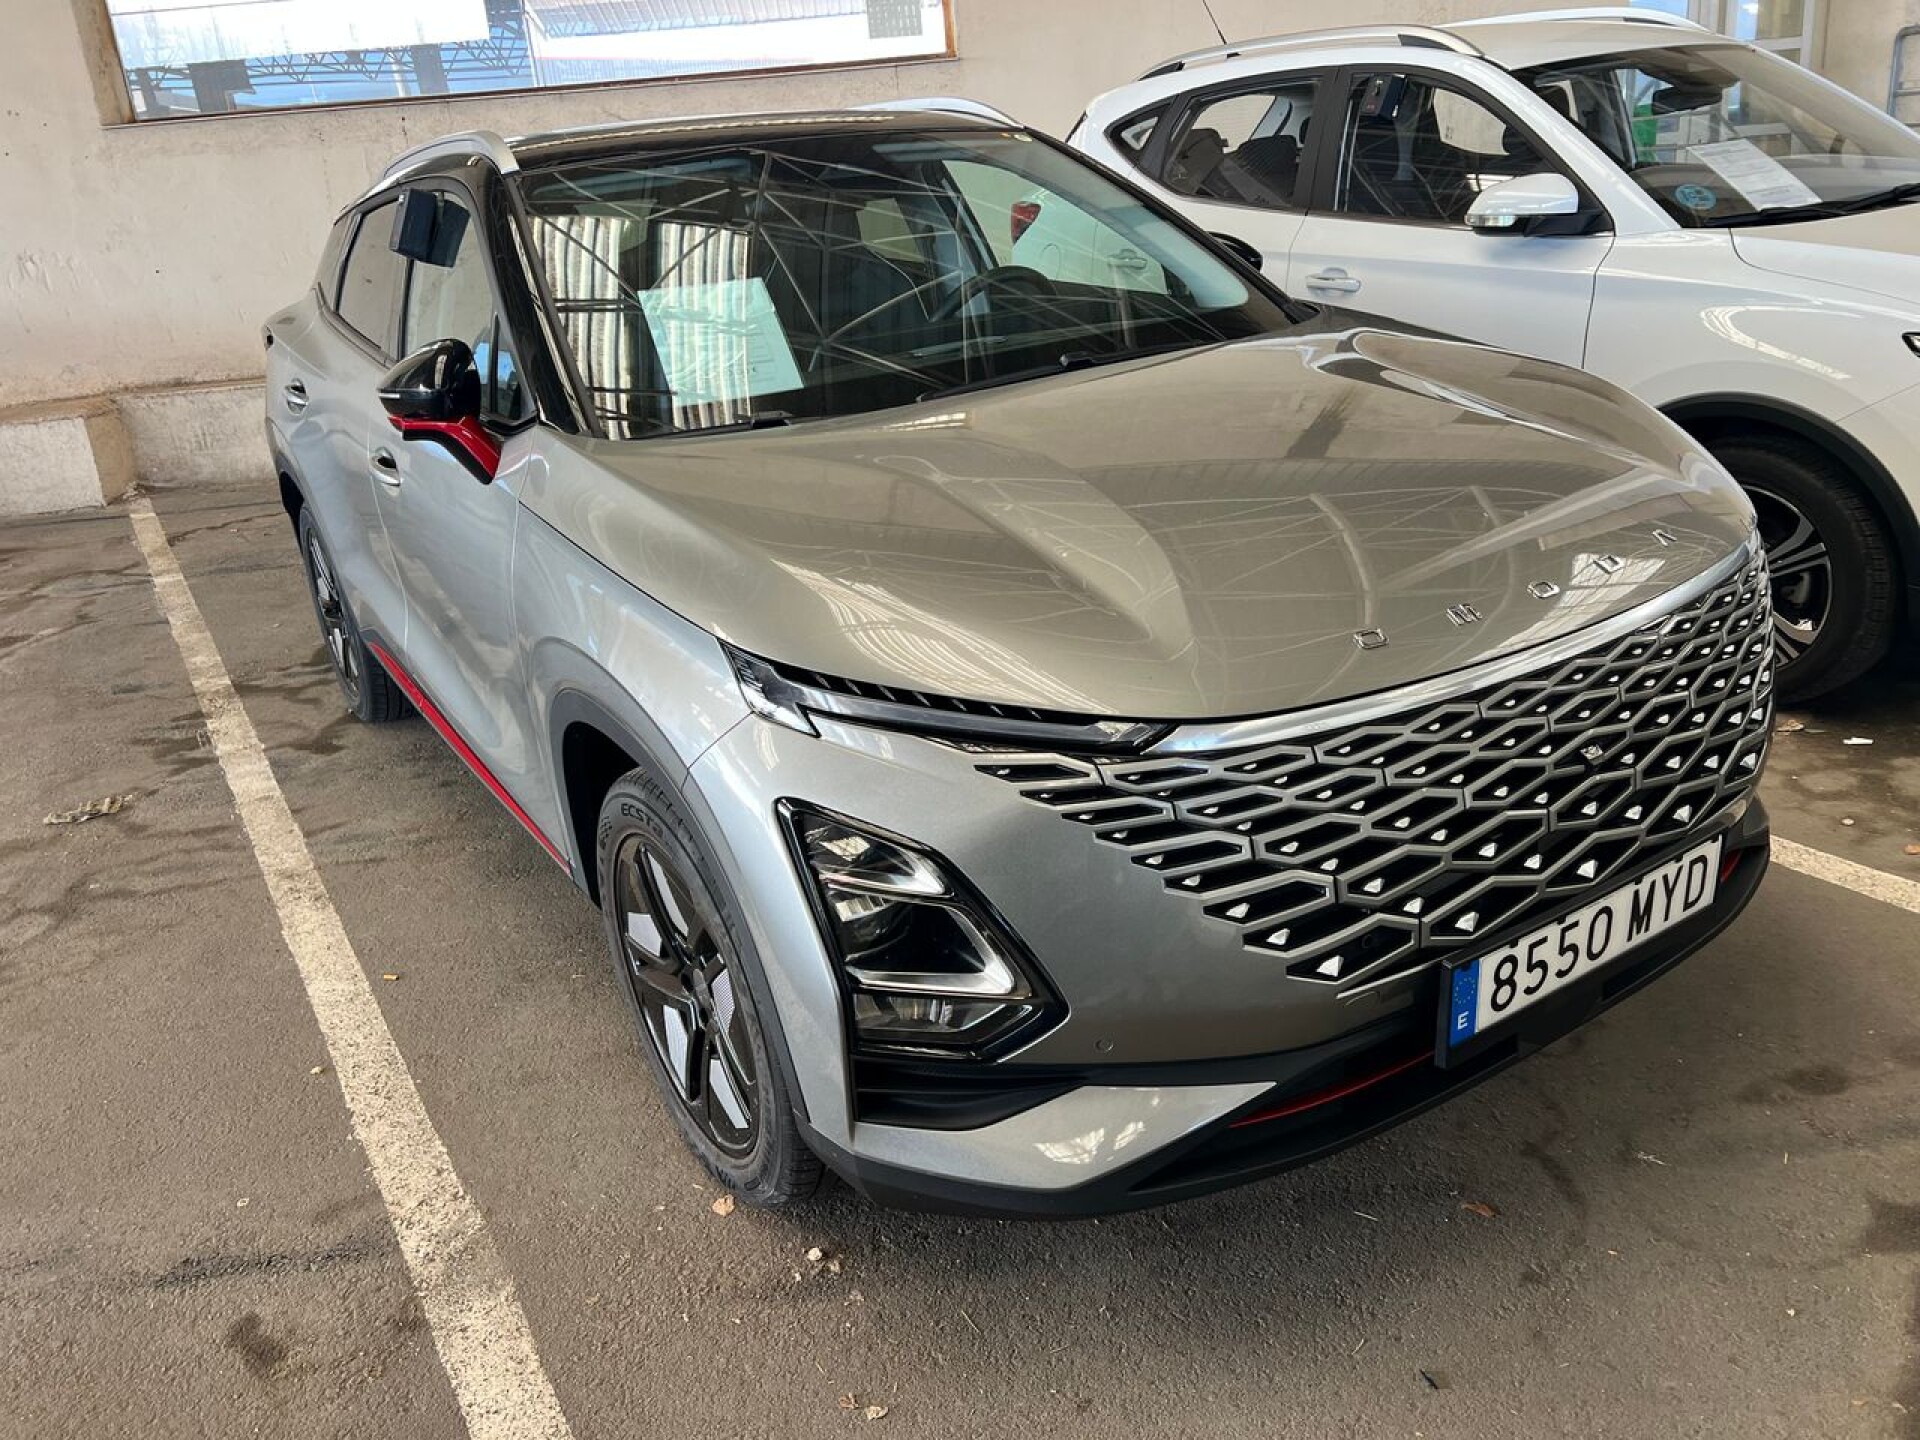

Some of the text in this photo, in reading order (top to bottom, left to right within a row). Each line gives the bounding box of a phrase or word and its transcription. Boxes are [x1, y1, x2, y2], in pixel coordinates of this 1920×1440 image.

[1490, 854, 1708, 1012] 8550 MYD
[1456, 1010, 1469, 1030] E
